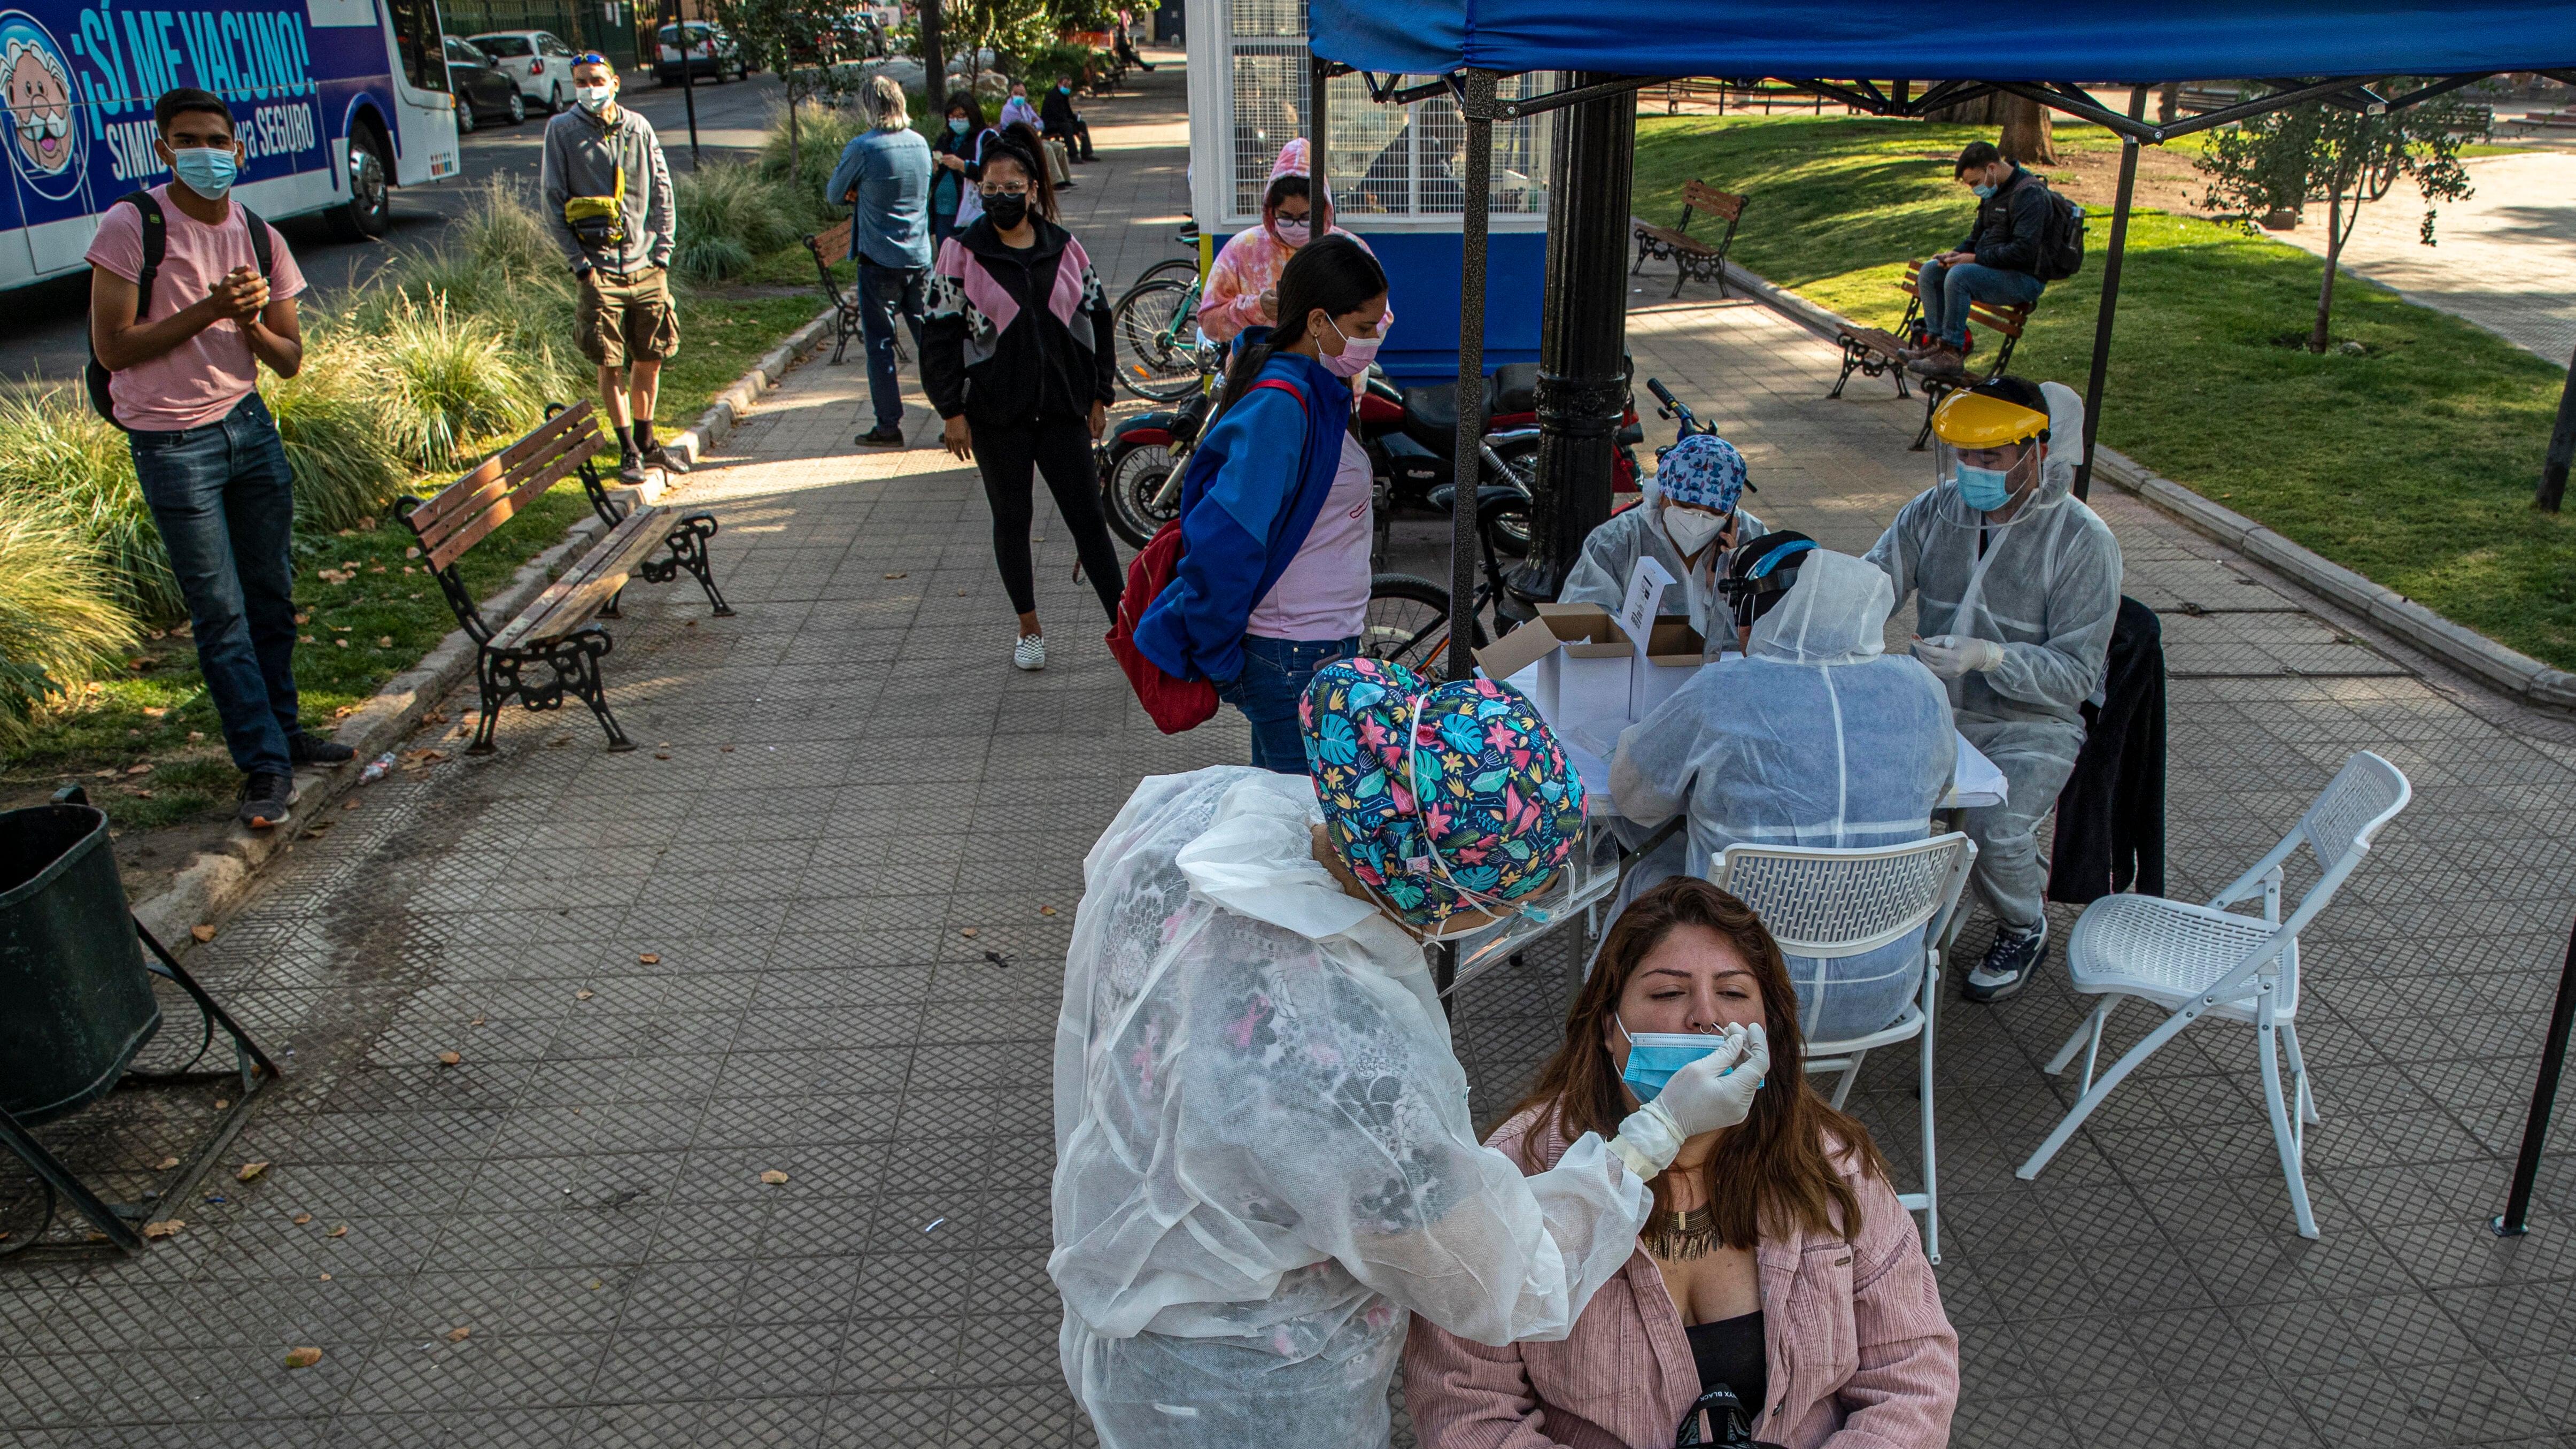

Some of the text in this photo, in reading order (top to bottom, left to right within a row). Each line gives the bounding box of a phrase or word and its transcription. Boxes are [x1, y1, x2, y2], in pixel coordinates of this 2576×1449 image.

[121, 11, 183, 111] ME
[177, 10, 316, 103] VACUNO!
[255, 102, 316, 157] SEGURO
[1700, 1391, 1723, 1401] BLACK
